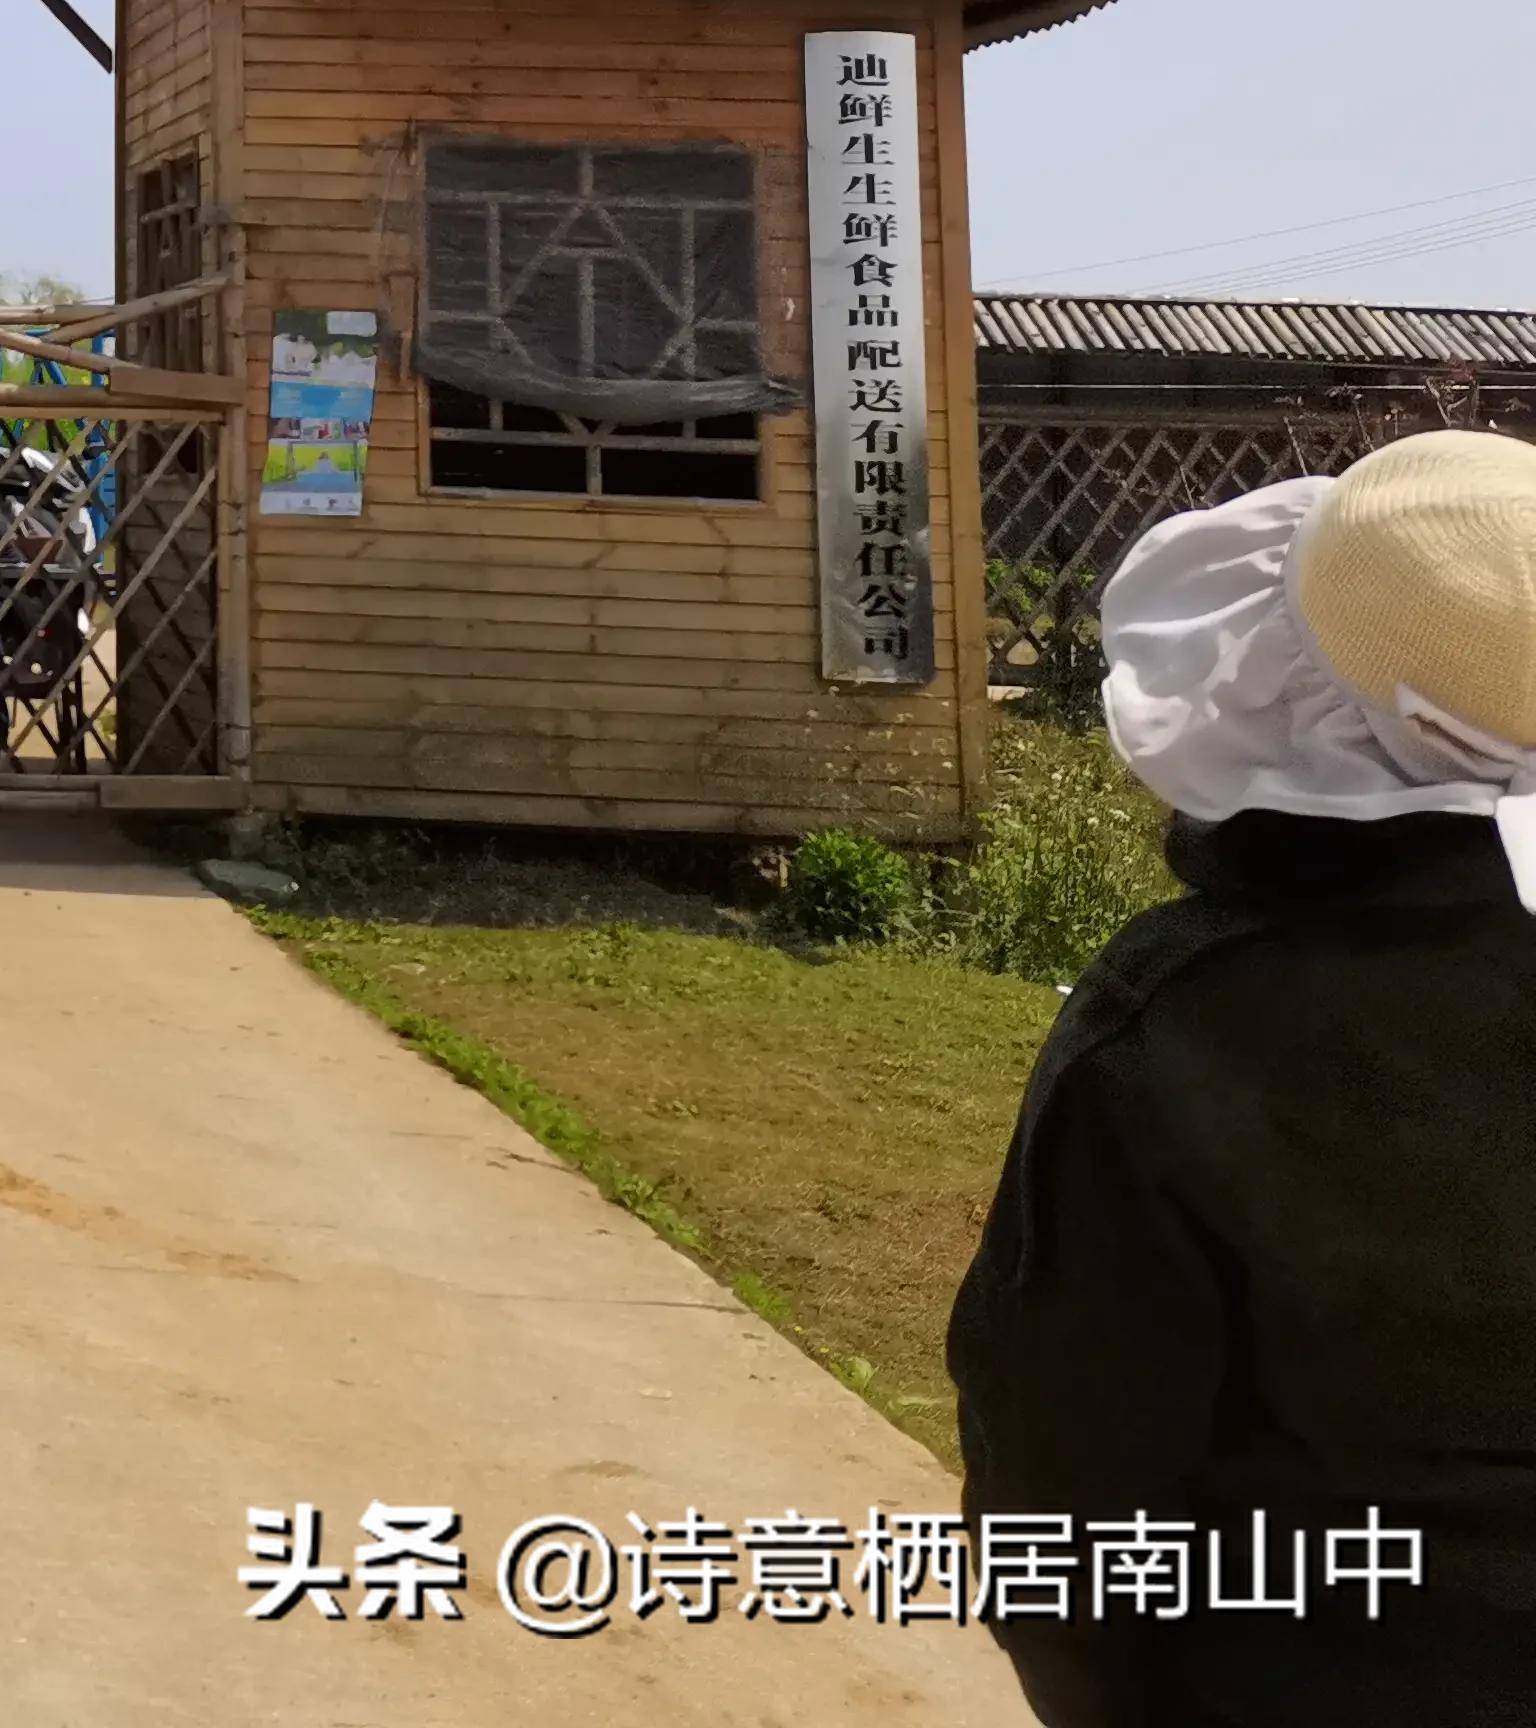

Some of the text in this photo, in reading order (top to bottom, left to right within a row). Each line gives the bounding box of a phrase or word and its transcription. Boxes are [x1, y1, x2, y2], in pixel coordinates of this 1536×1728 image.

[836, 52, 910, 662] 迪鲜生生鲜食品配送有限责任公司
